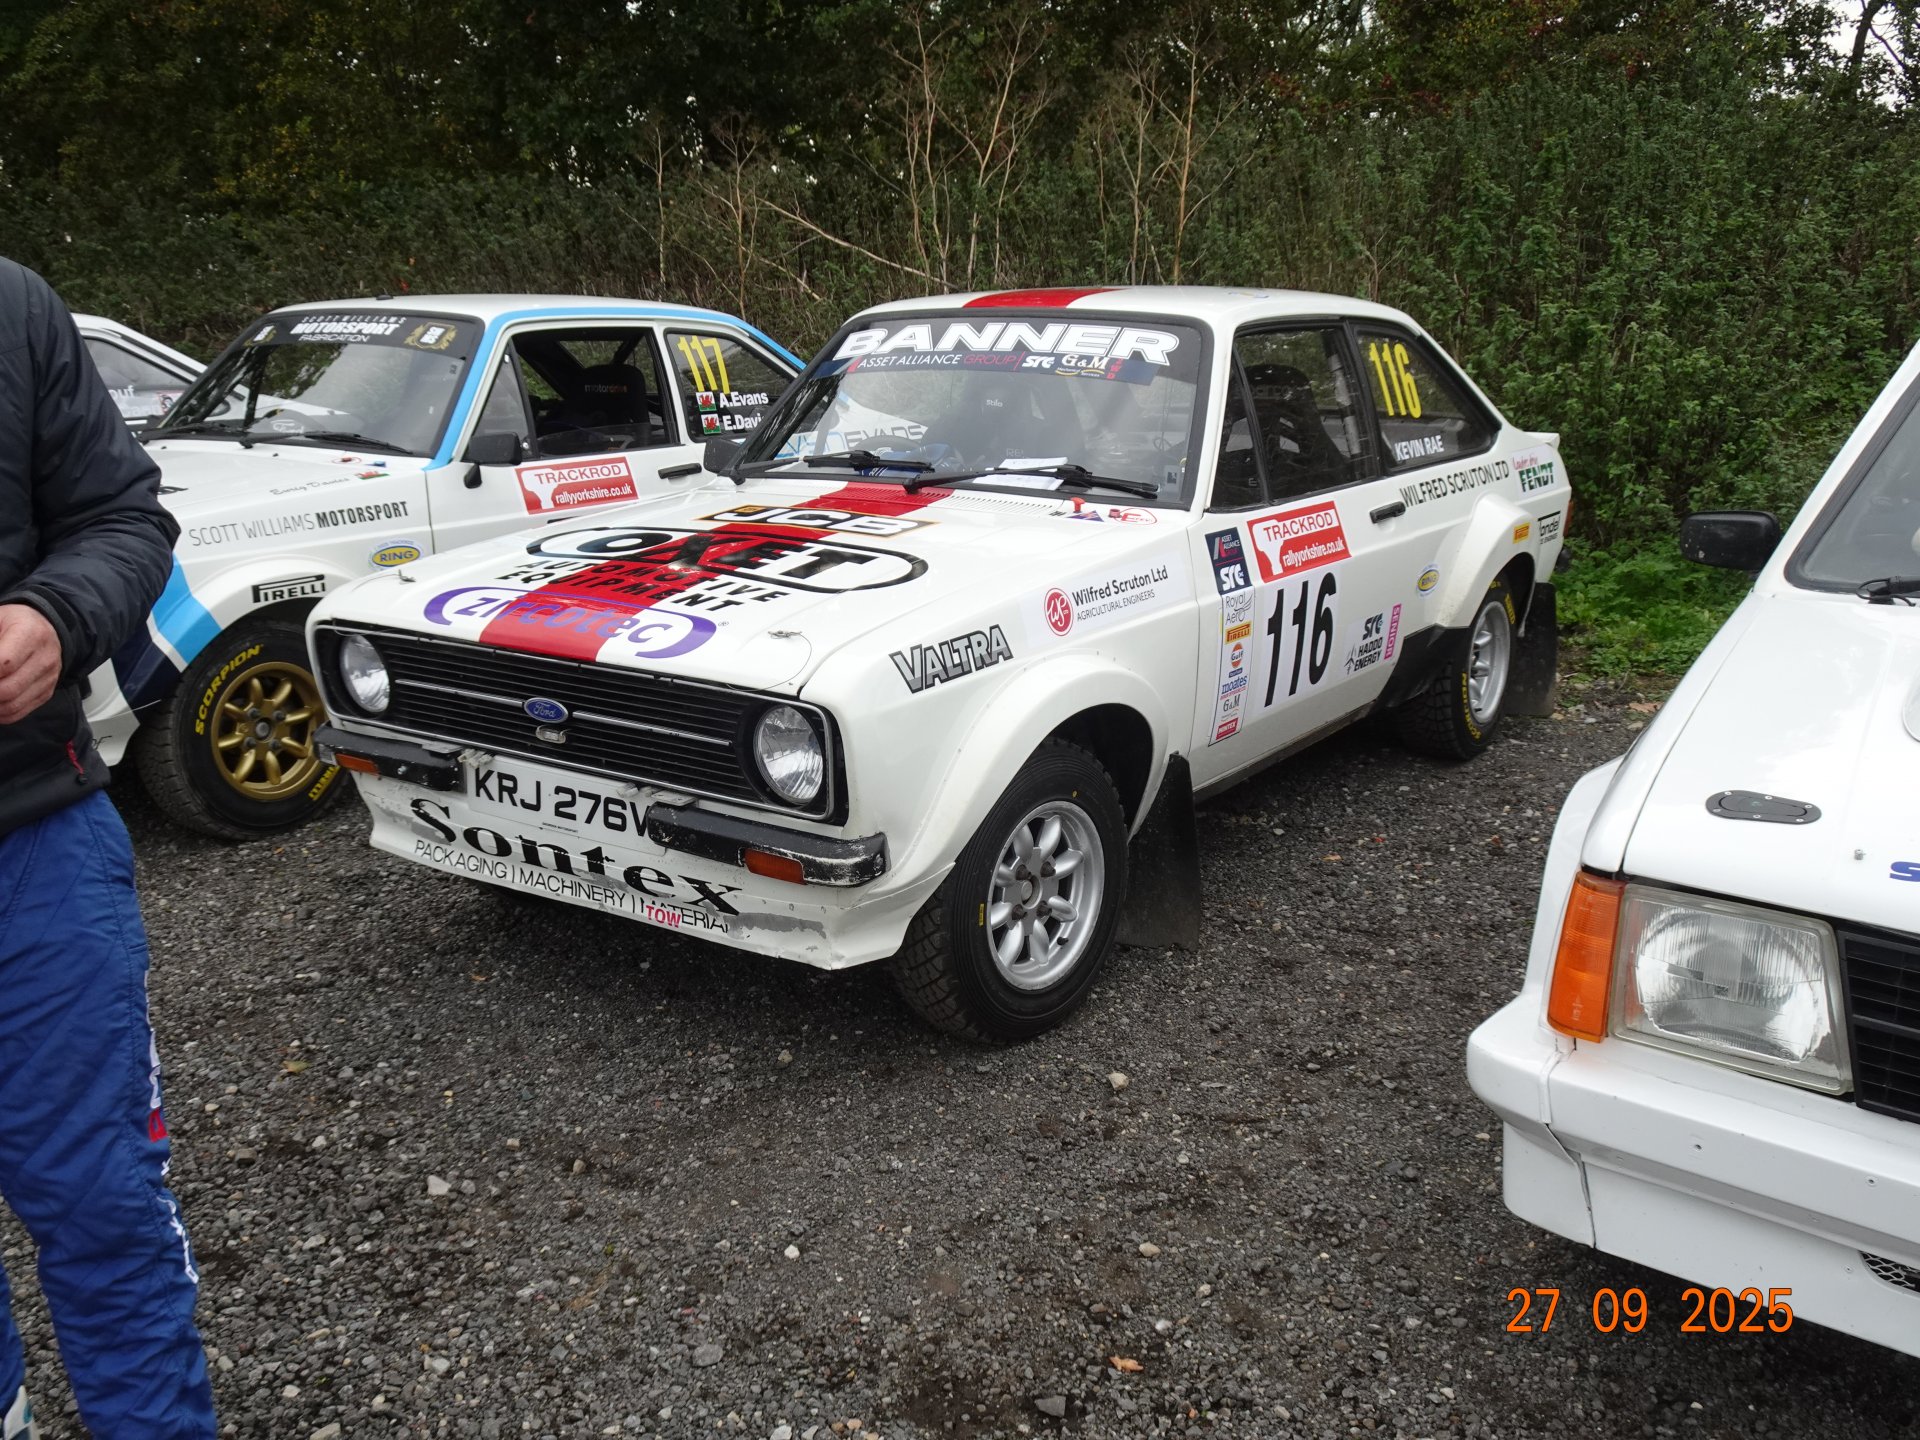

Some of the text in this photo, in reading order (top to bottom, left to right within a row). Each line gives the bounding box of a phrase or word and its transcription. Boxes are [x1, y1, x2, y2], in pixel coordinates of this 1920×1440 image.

[290, 322, 401, 336] MOTORSPORT
[341, 315, 407, 324] WILLIAMS
[298, 334, 370, 342] FABRICATION
[832, 322, 1180, 366] BANNER
[677, 335, 730, 395] 117
[857, 355, 896, 369] ASSET
[896, 354, 963, 366] ALLIANCE
[963, 354, 1017, 366] GROUP
[1061, 354, 1110, 371] G&M
[1369, 342, 1422, 419] 116
[719, 391, 769, 409] A.Evans
[1394, 434, 1444, 461] KEVIN RAE
[534, 464, 622, 485] TRACKROD
[1400, 477, 1448, 508] WILFRED
[1446, 465, 1494, 495] SCRUTON
[1493, 460, 1509, 481] LTD
[1518, 461, 1554, 493] FENDT
[556, 483, 632, 505] rallyyorkshire.co.uk
[188, 501, 410, 547] SCOTT WILLIAMS MOTORSPORT
[712, 507, 919, 538] JCB
[1263, 512, 1334, 542] TRACKROD
[380, 550, 414, 562] RING
[576, 530, 881, 581] OXET
[1282, 537, 1345, 567] rallyyorkshire.co.uk
[251, 574, 326, 604] PIRELLI
[494, 570, 745, 613] EQUIPMENT
[514, 560, 792, 603] AUTOMOTIVE
[1072, 564, 1169, 607] Wilfred Scruton Ltd
[1077, 588, 1156, 622] AGRICULTURAL ENGINEERS
[1225, 591, 1246, 609] Royal
[453, 594, 674, 644] zircotec
[1225, 608, 1246, 626] Aero
[1226, 623, 1251, 643] PIRELLI
[1264, 572, 1337, 708] 116
[1357, 636, 1383, 658] HADDO
[888, 623, 1015, 694] VALTRA
[1231, 651, 1244, 661] Gulf
[1353, 649, 1383, 672] ENERGY
[195, 644, 263, 736] SCORPION
[1221, 676, 1248, 695] moates
[533, 701, 558, 718] Ford
[475, 767, 541, 812] KRJ
[410, 797, 743, 917] Sontex
[414, 839, 508, 879] PACKAGING
[519, 866, 626, 909] MACHINERY
[646, 904, 681, 929] TOW
